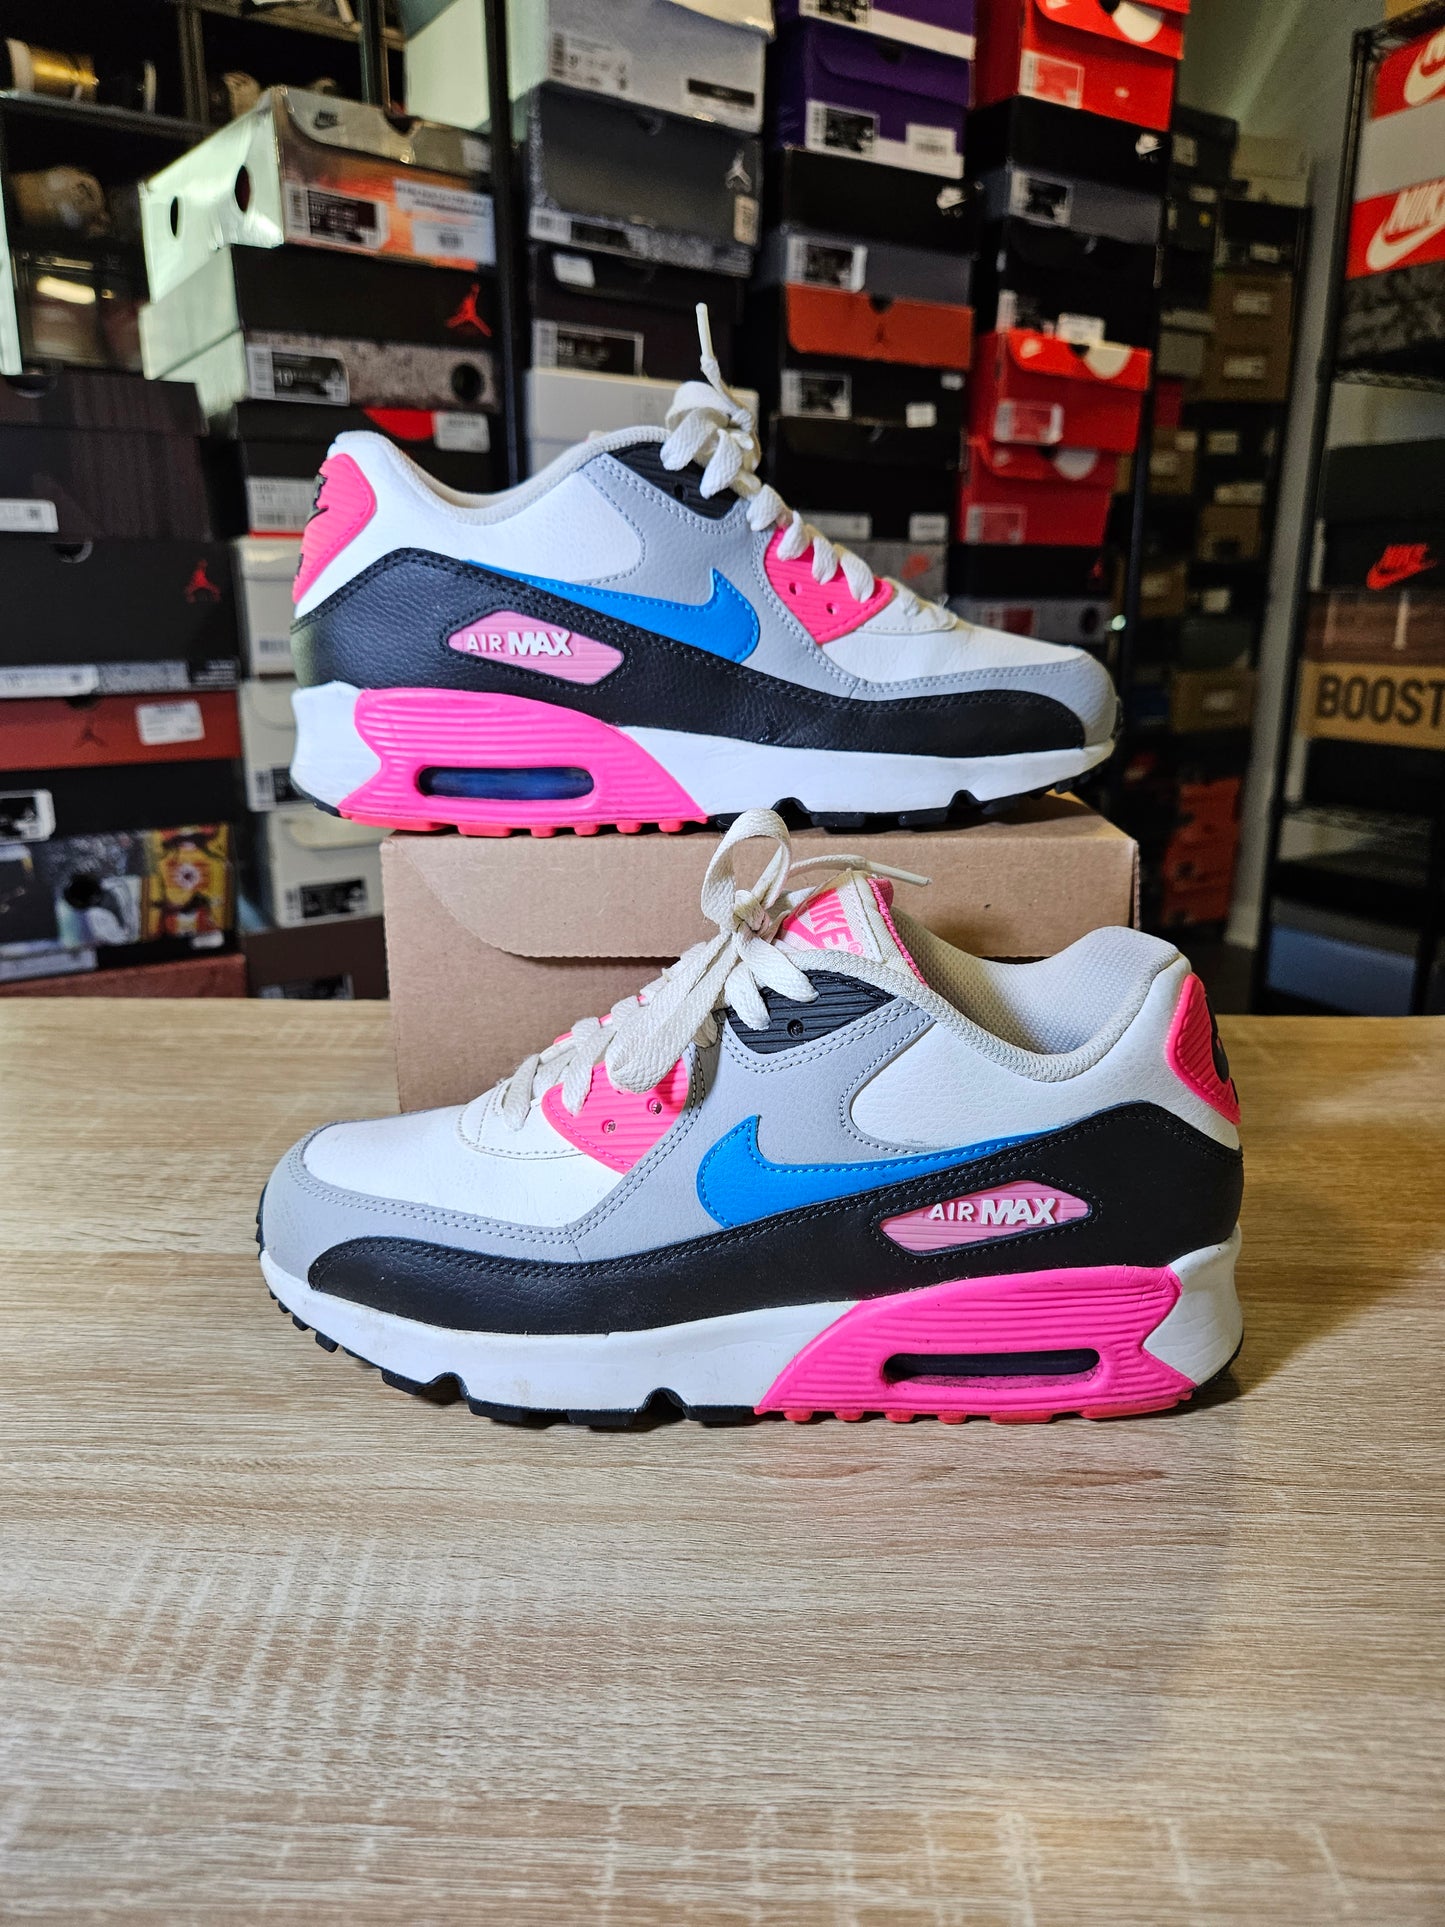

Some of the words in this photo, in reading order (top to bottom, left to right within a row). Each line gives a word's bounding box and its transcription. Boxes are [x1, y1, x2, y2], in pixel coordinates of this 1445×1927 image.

[467, 633, 503, 652] AIR
[507, 630, 573, 657] MAX
[1316, 673, 1445, 730] BOOST
[928, 1202, 975, 1221] AIR
[980, 1198, 1056, 1225] MAX
